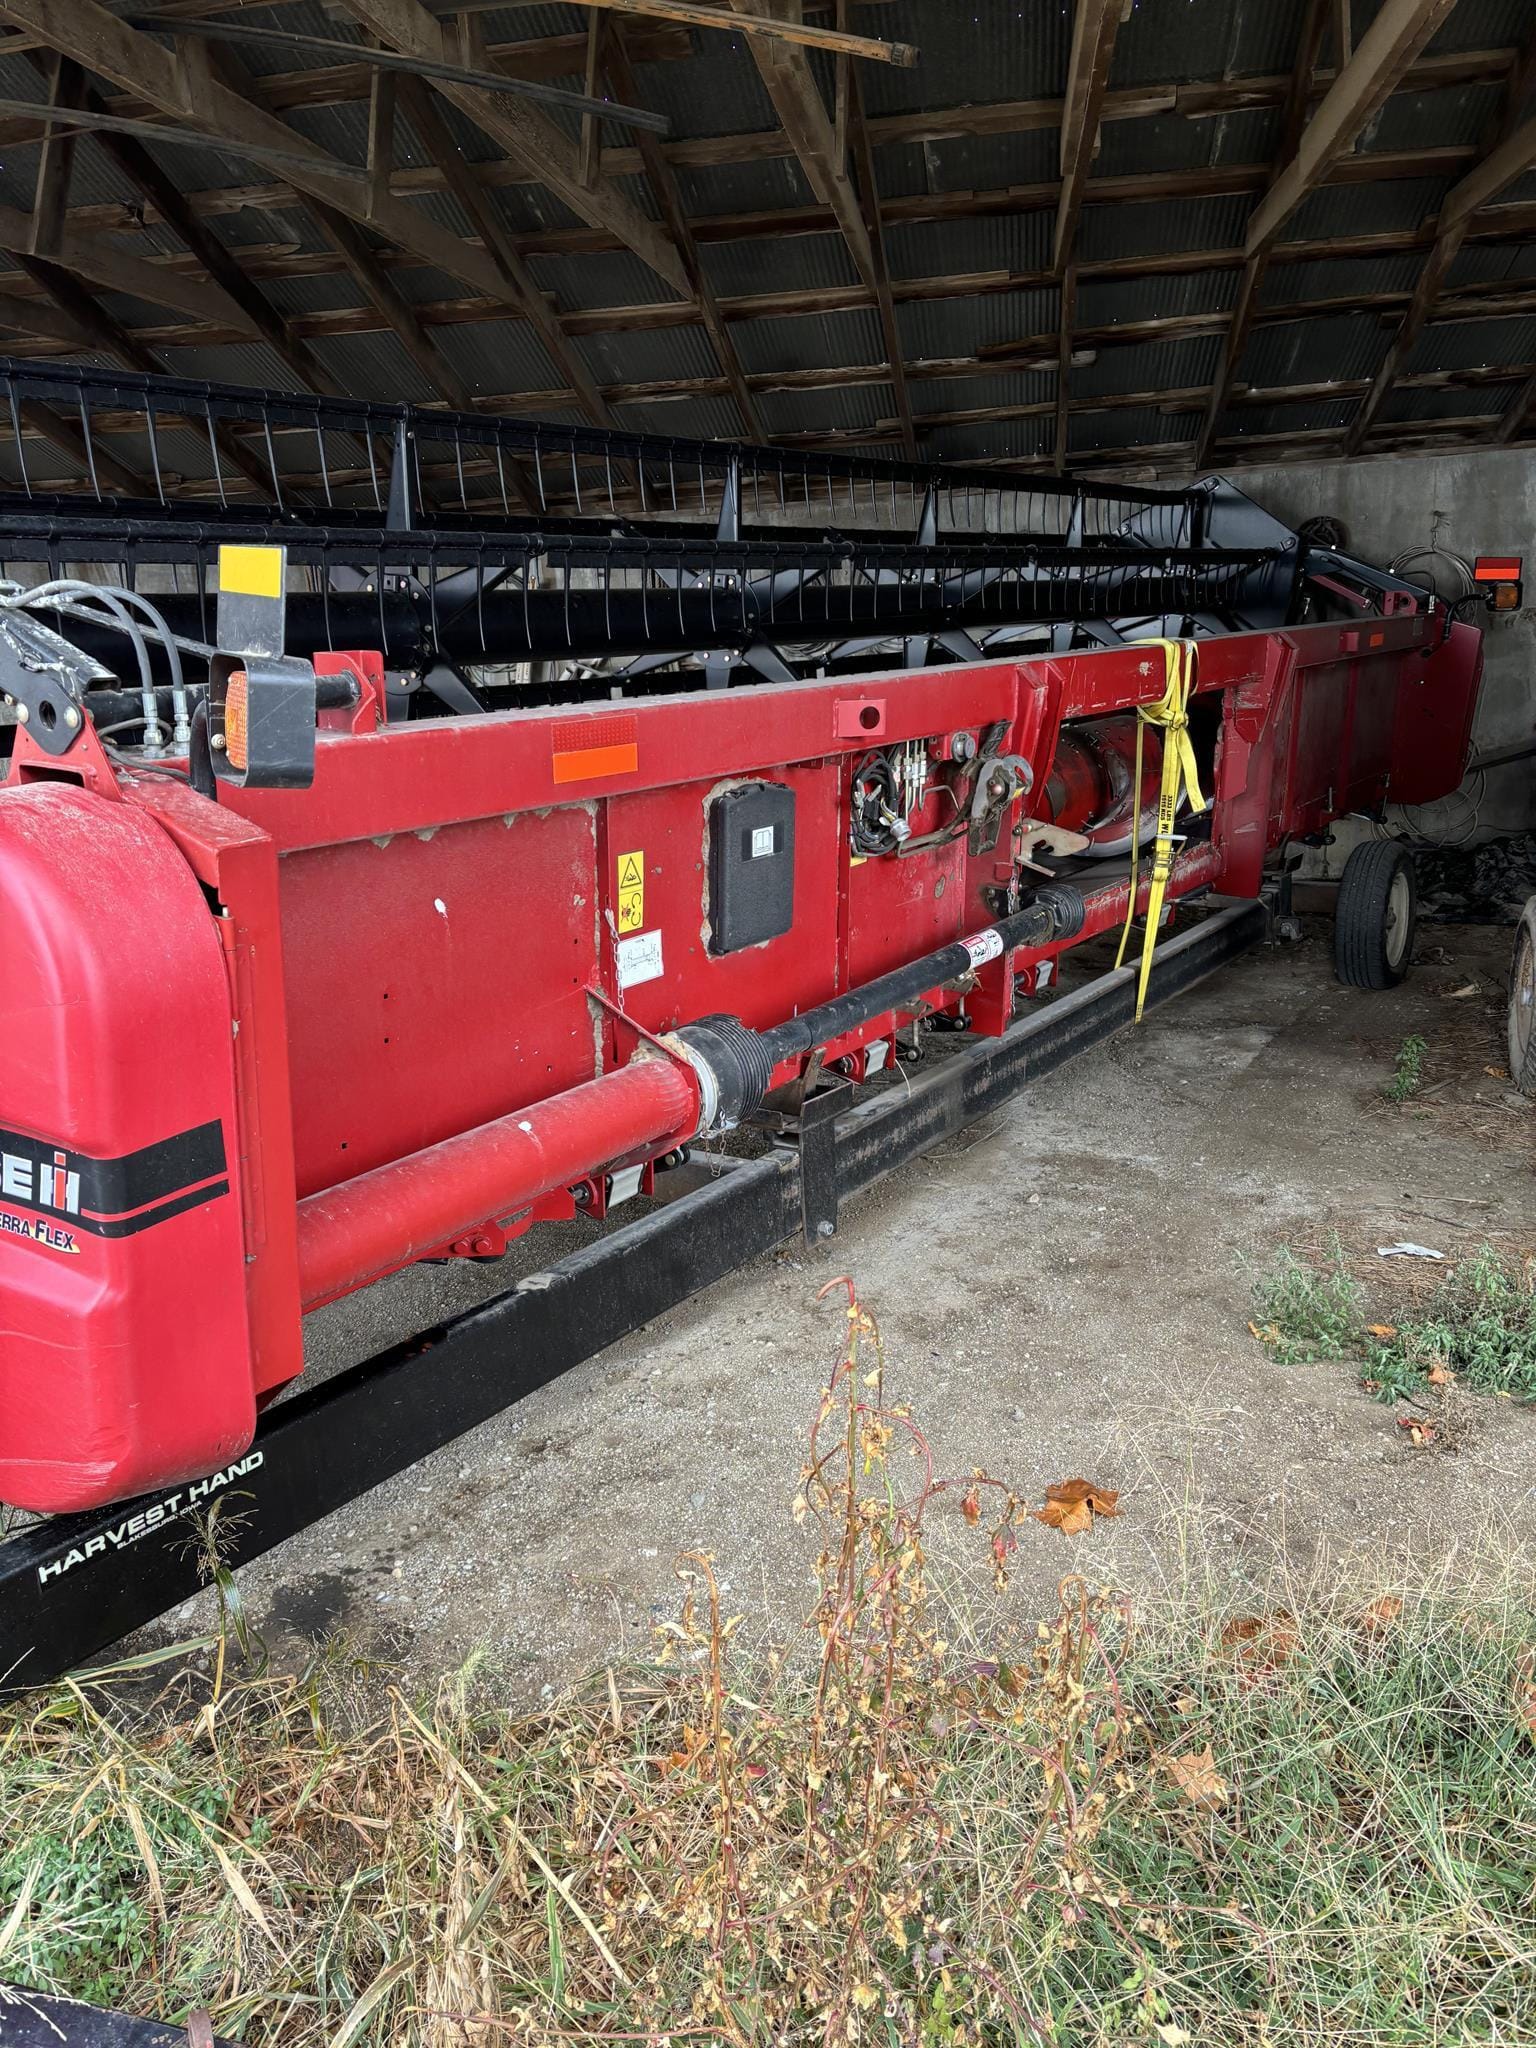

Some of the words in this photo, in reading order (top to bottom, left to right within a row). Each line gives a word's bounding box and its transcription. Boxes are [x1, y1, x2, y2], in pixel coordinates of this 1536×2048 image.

[0, 1152, 33, 1201] E
[38, 1494, 183, 1584] HARVEST
[189, 1451, 264, 1503] HAND
[180, 1500, 203, 1516] IOWA
